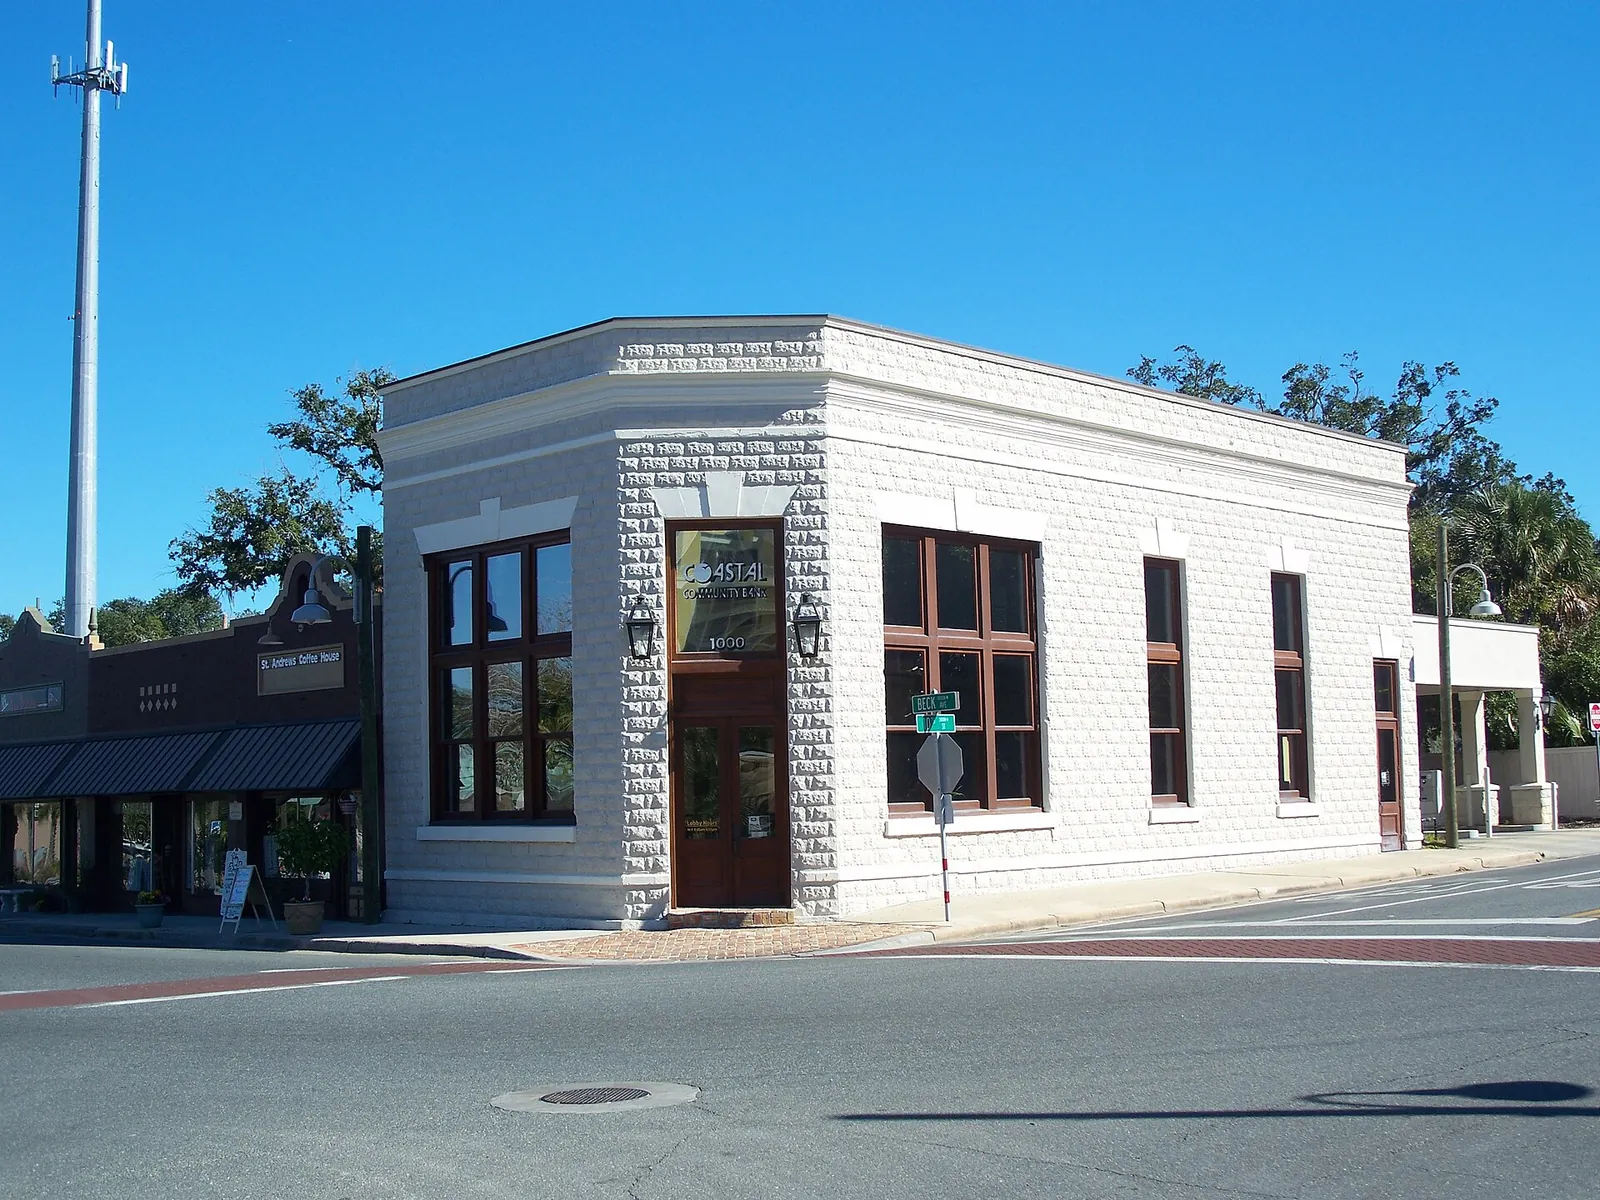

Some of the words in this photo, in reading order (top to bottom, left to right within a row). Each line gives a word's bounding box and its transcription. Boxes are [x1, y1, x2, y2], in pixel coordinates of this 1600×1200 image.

[684, 562, 767, 583] COASTAL
[683, 588, 740, 599] COMMUNITY
[742, 588, 767, 599] BANK
[710, 637, 745, 650] 1000
[271, 657, 297, 669] Andrews
[298, 653, 318, 665] Coffee
[320, 651, 340, 663] House
[917, 697, 936, 711] BECK
